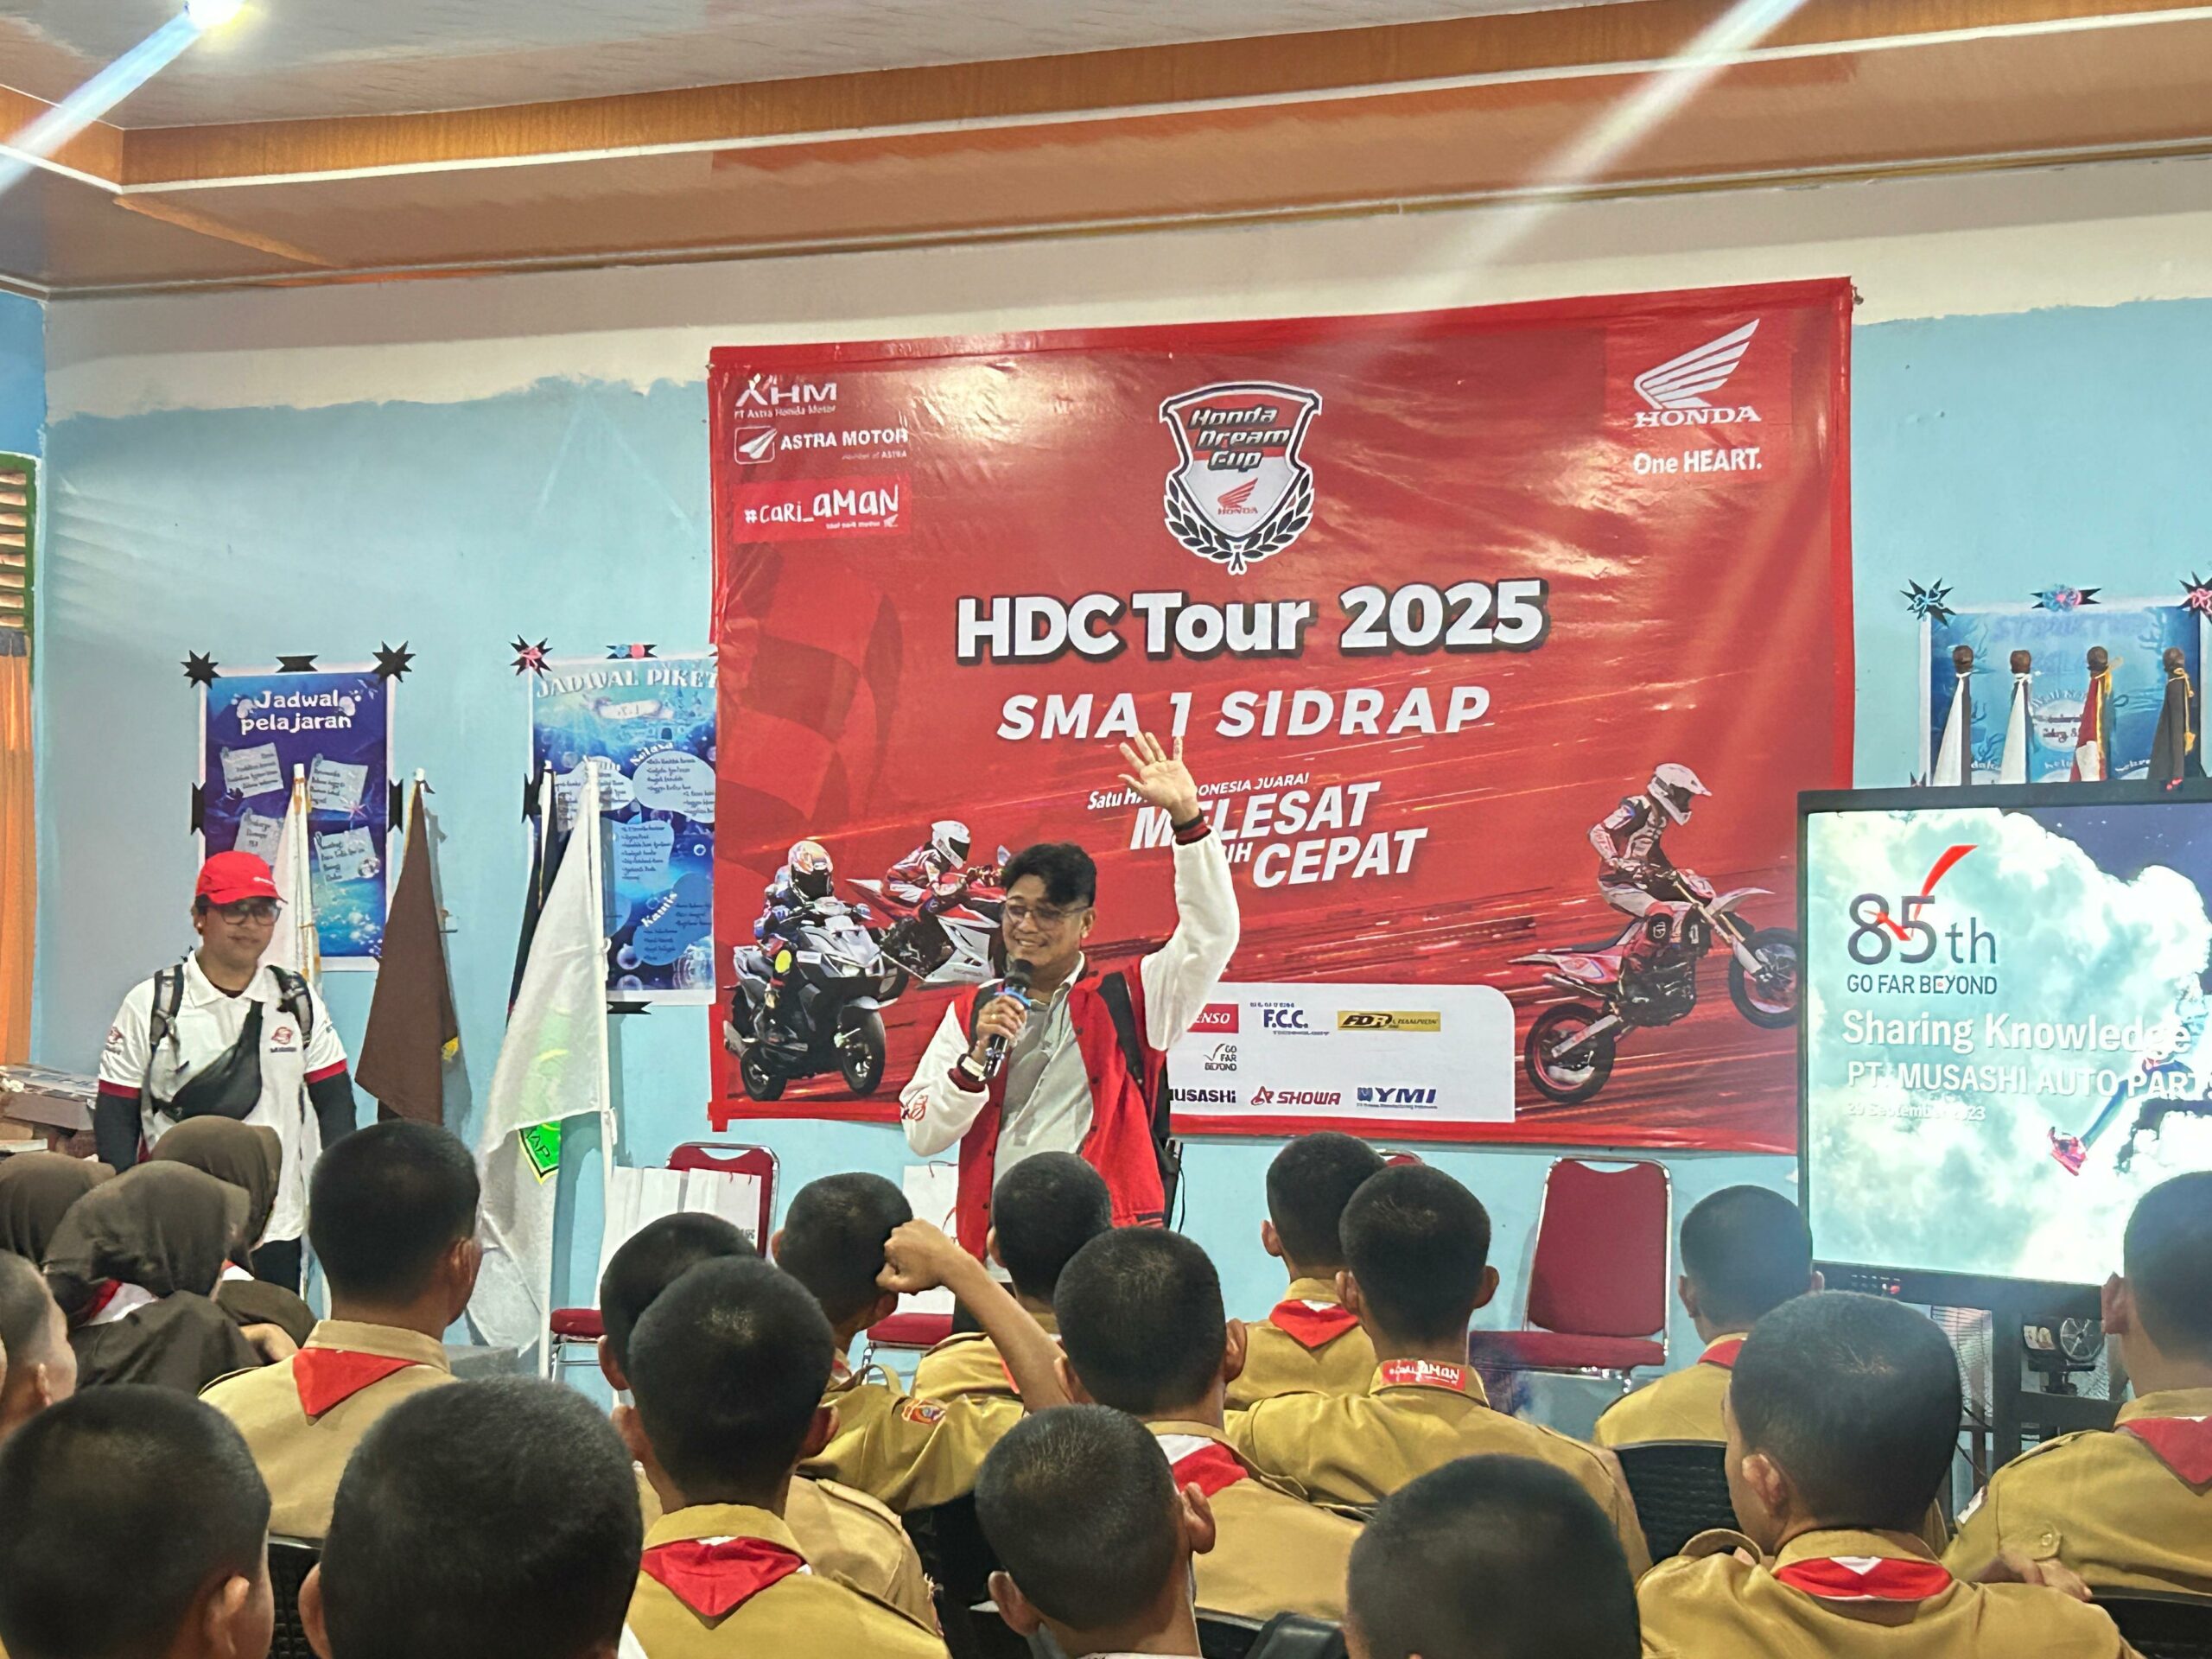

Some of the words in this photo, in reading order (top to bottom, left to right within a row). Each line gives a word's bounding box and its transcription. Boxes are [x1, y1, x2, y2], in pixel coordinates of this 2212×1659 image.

[1190, 406, 1277, 426] Honda
[1633, 405, 1762, 428] HONDA
[780, 432, 837, 450] ASTRA
[842, 427, 909, 447] MOTOR
[1197, 429, 1290, 448] Dream
[1211, 449, 1262, 469] Cup
[1633, 452, 1678, 474] One
[1684, 447, 1762, 473] HEART.
[956, 593, 1122, 662] HDC
[1132, 591, 1311, 657] Tour
[1338, 580, 1547, 652] 2025
[537, 670, 639, 698] JADWAL
[254, 690, 338, 709] Jadwal
[240, 712, 352, 735] pelajaran
[997, 692, 1139, 740] SMA
[1171, 692, 1193, 737] 1
[1216, 686, 1491, 738] SIDRAP
[1087, 791, 1122, 810] Satu
[1252, 828, 1428, 888] CEPAT
[1847, 974, 1873, 994] GO
[1878, 975, 1915, 994] FAR
[1920, 976, 1998, 995] BEYOND
[1264, 1009, 1308, 1028] F.C.C.
[1340, 1014, 1393, 1028] FDR
[1842, 1009, 1974, 1055] Sharing
[1986, 1013, 2191, 1062] Knowledge
[1901, 1064, 2029, 1095] MUSASHI
[2036, 1067, 2119, 1097] AUTO
[1277, 1091, 1341, 1105] SHOWA
[1376, 1088, 1436, 1103] YMI
